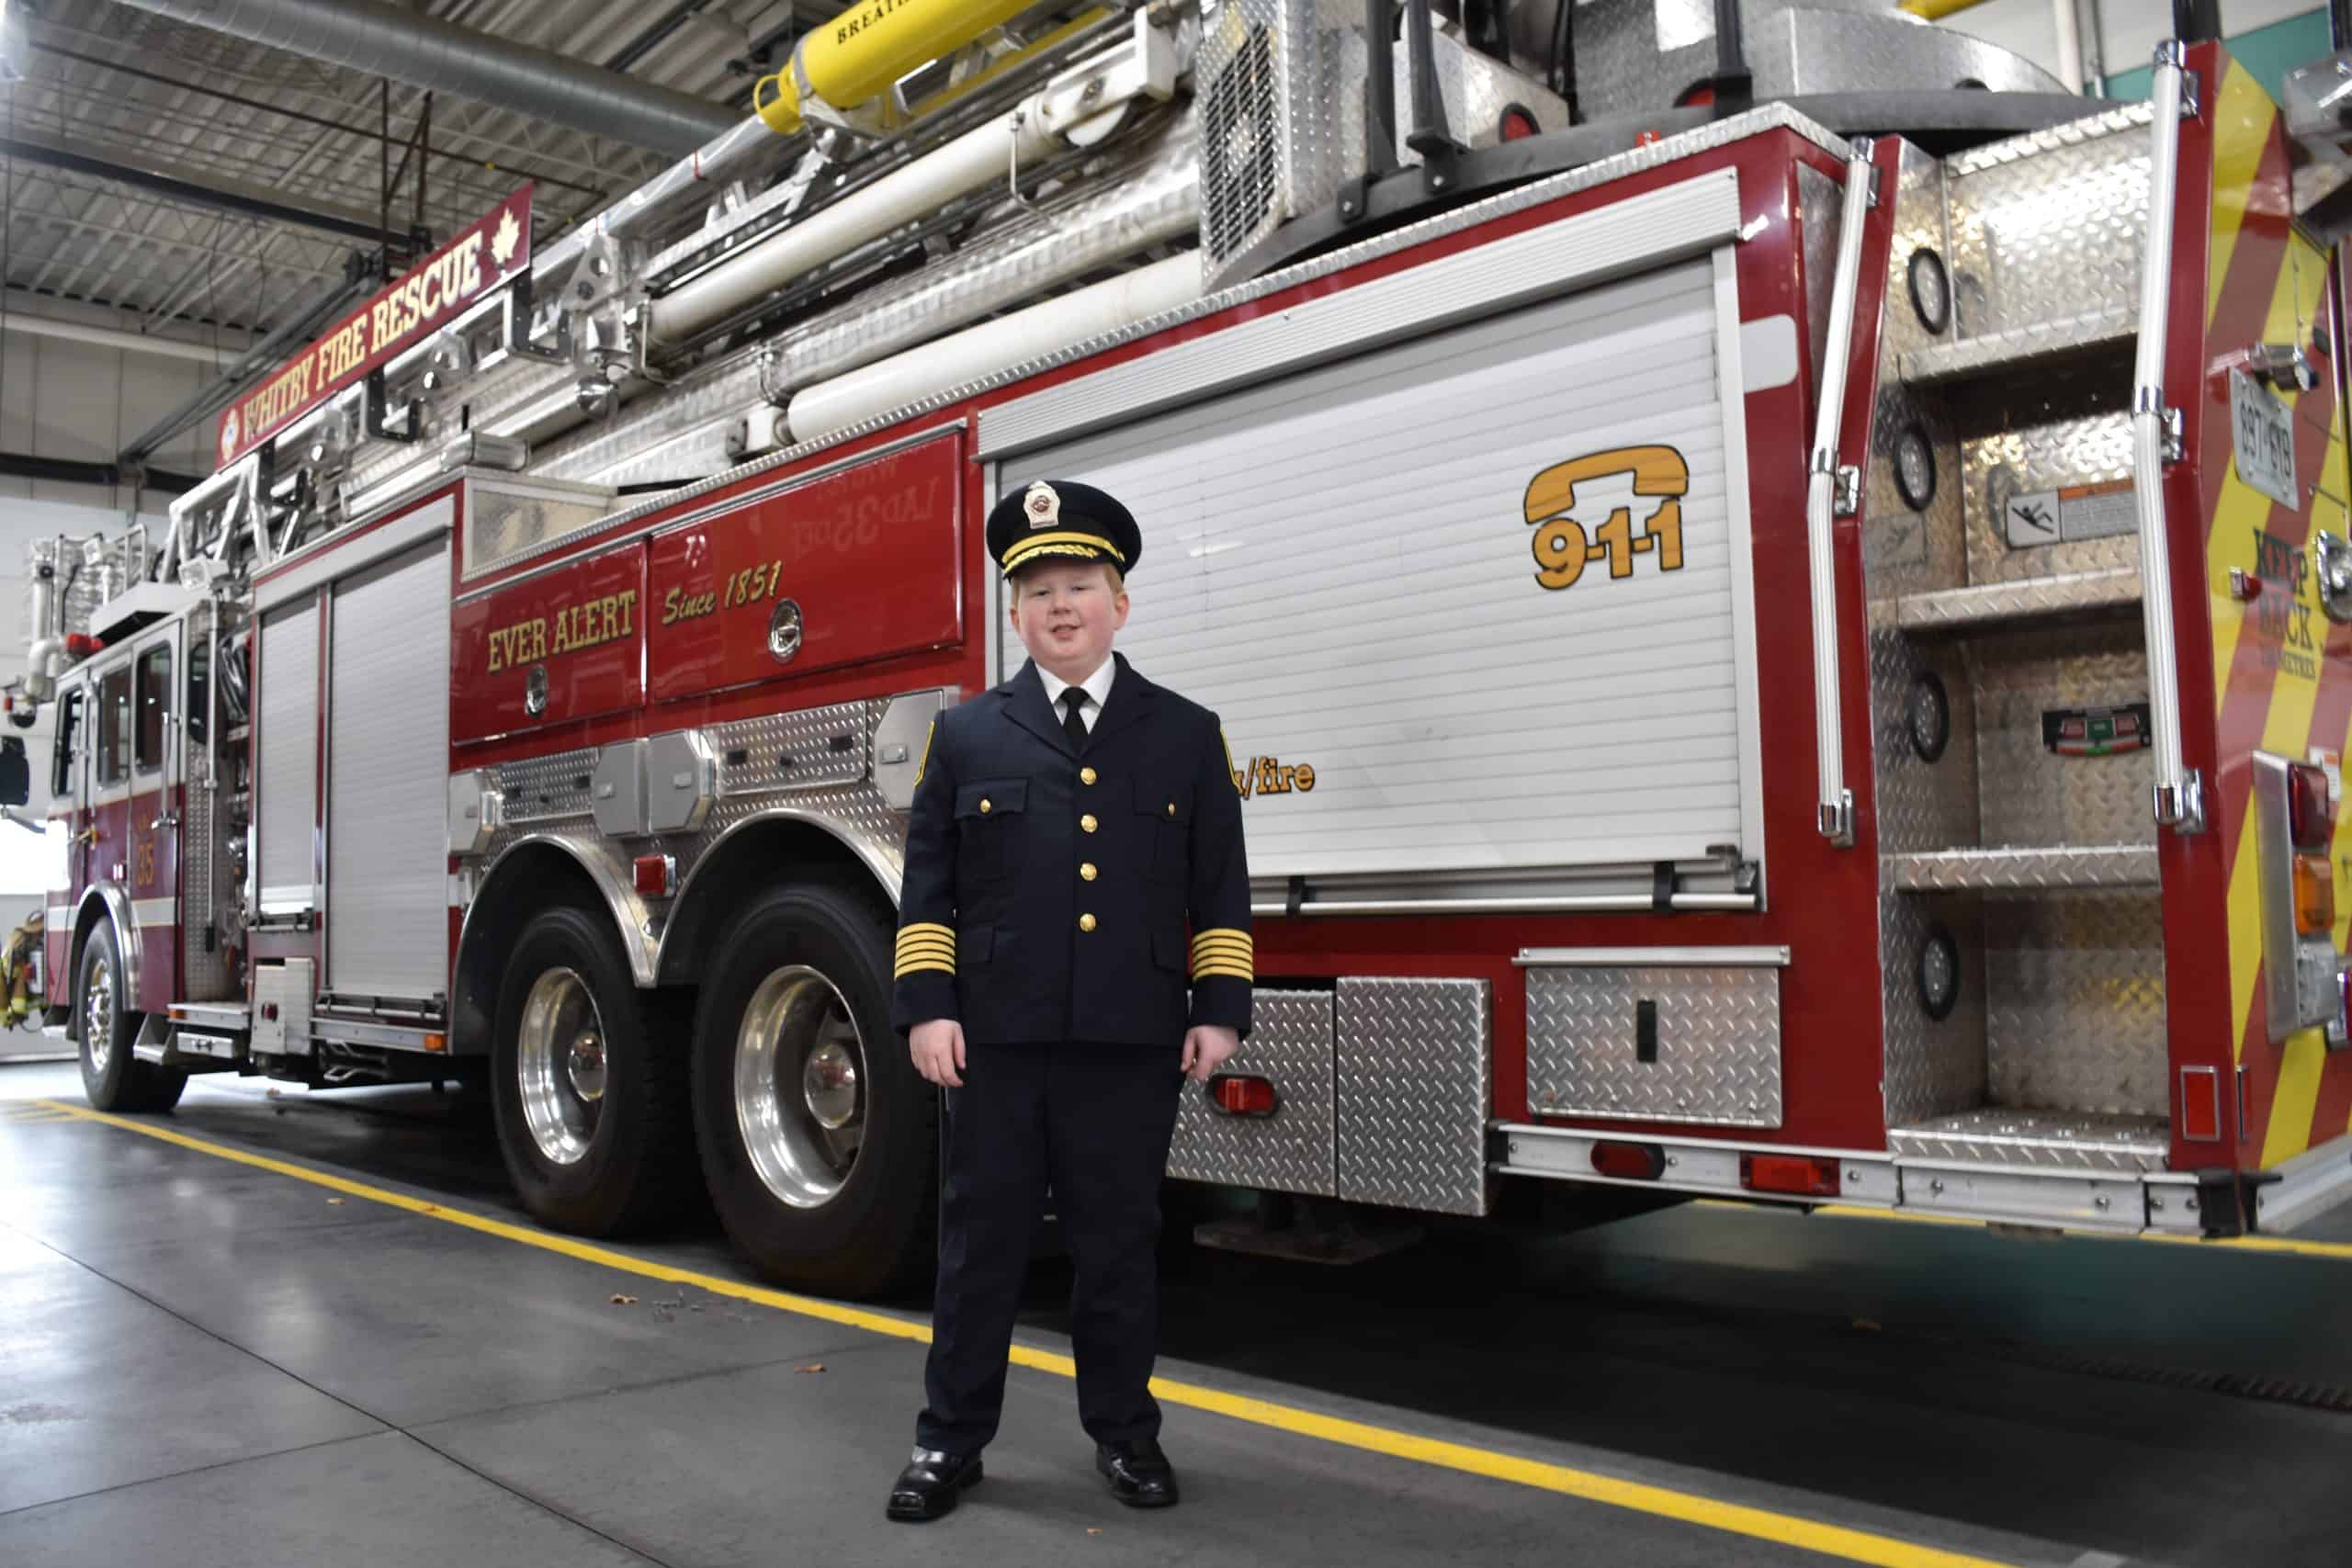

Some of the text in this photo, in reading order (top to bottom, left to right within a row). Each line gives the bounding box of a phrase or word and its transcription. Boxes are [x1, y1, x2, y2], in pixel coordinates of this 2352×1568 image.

[836, 0, 910, 44] BREAT
[243, 230, 483, 444] WHITBY FIRE RESCUE
[1532, 495, 1685, 591] 9-1-1
[2253, 526, 2309, 598] KEEP
[487, 589, 637, 673] EVER ALERT
[661, 558, 783, 626] Since 1851
